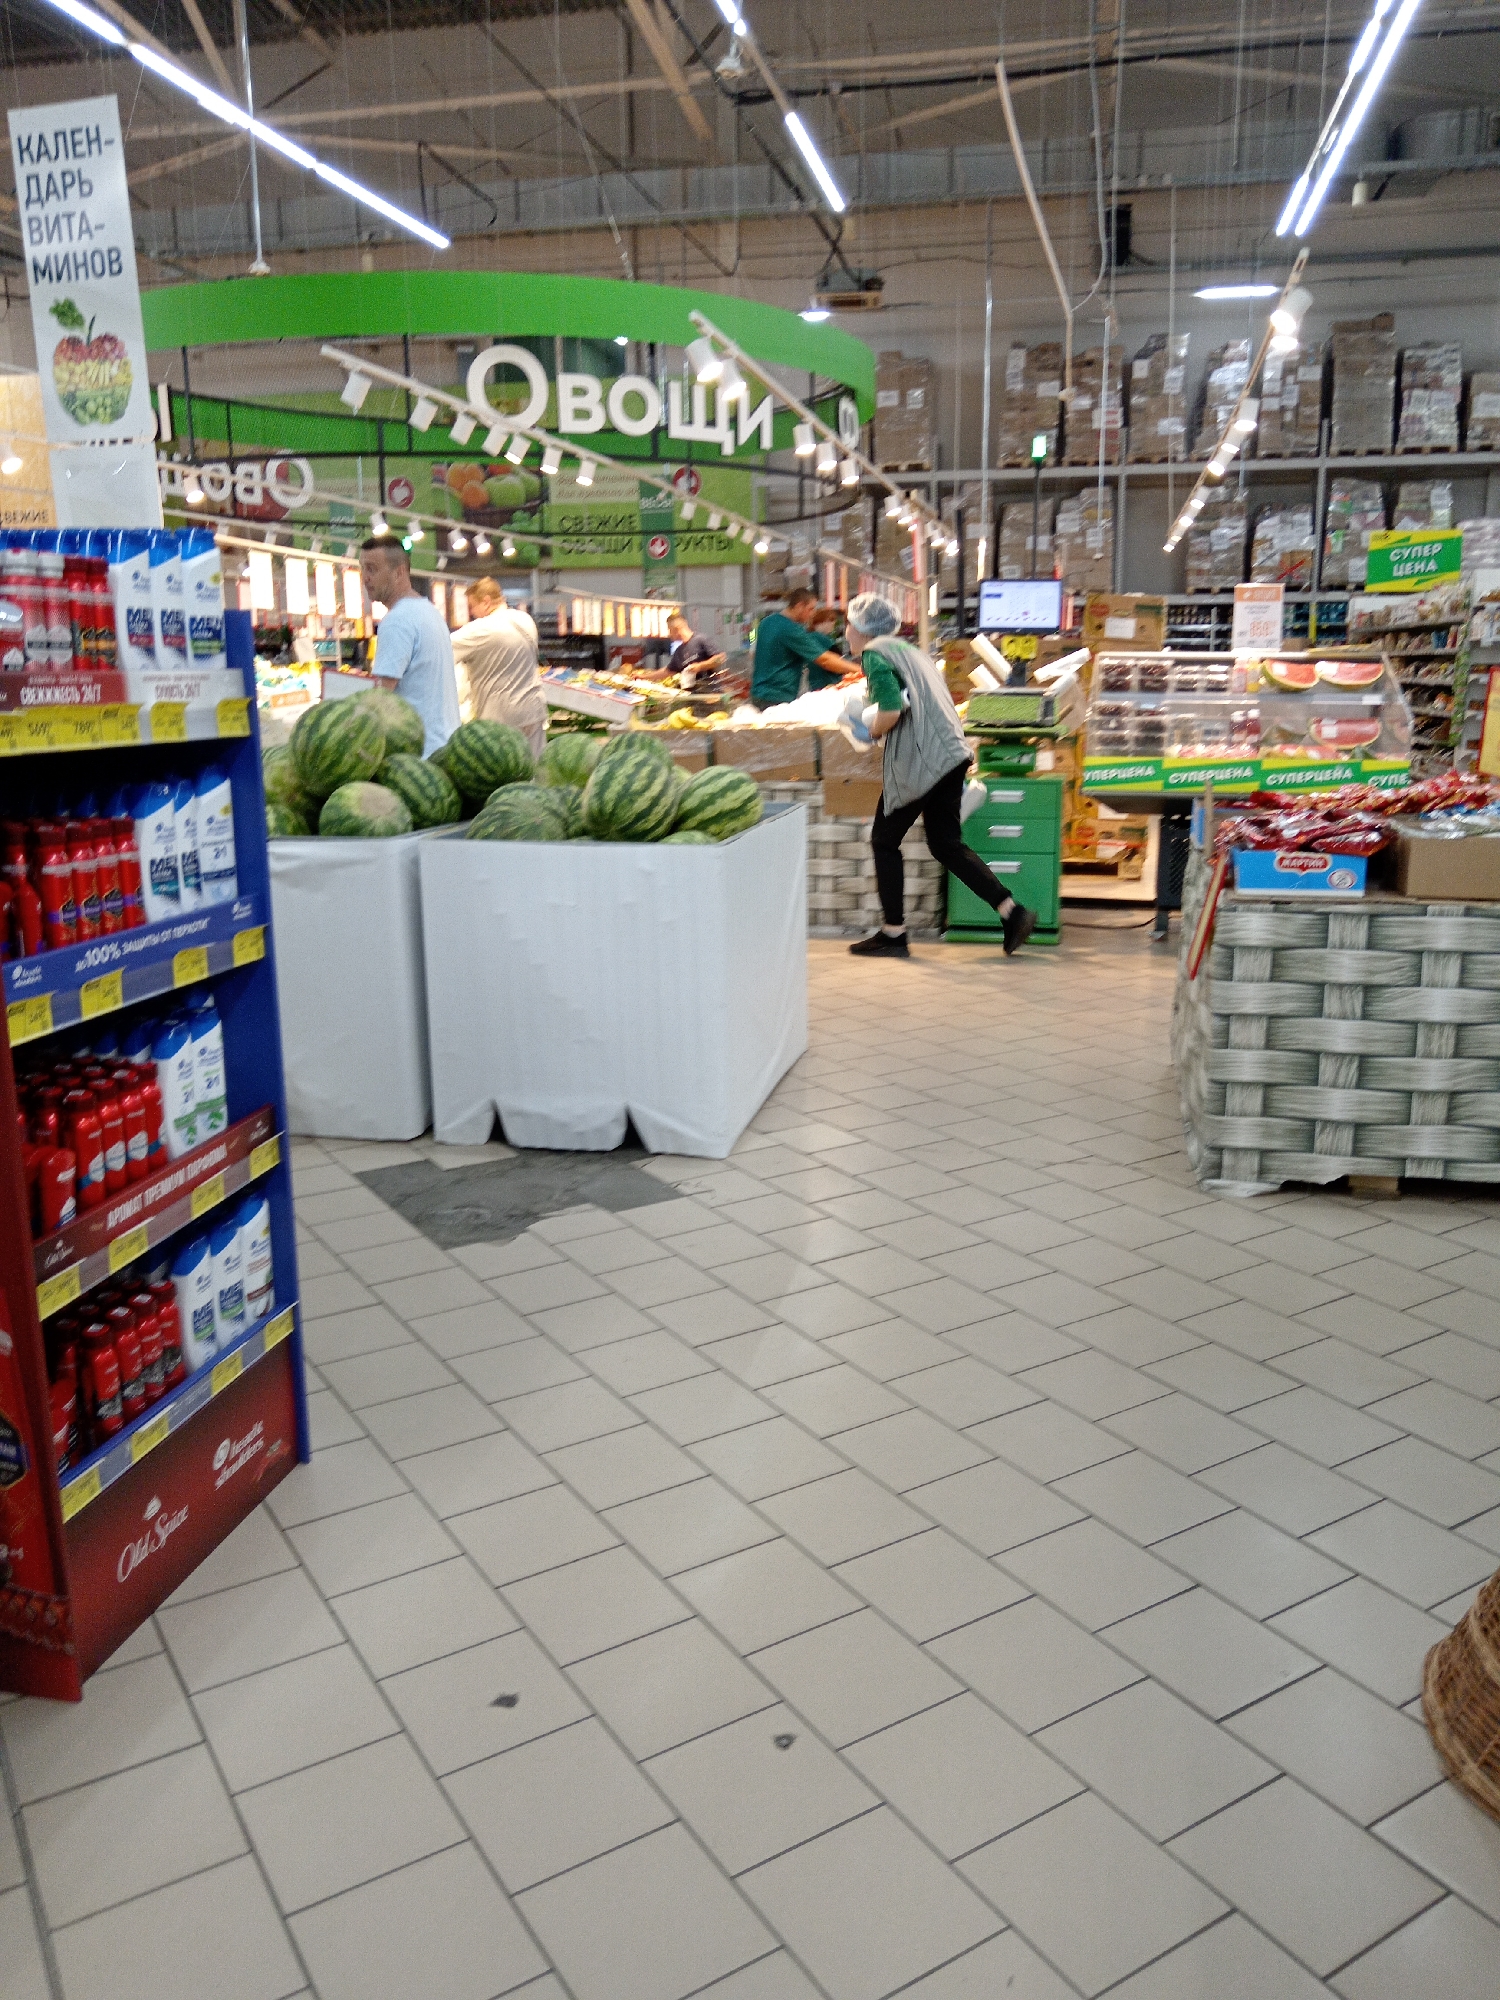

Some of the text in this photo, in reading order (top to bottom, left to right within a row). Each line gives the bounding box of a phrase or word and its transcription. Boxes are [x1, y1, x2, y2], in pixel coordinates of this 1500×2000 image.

[17, 125, 115, 165] КАЛЕН-
[25, 167, 93, 210] ДАРЬ
[27, 210, 105, 246] ВИТА-
[32, 246, 123, 285] МИНОВ
[558, 513, 637, 534] СВЕЖИЕ
[674, 533, 733, 552] РУКТЫ
[1389, 543, 1443, 562] СУПЕР
[1392, 559, 1438, 577] ЦЕНА
[1084, 765, 1411, 788] УПЕРЦЕНА СУПЕРЦЕНА СУПЕРЦЕНА СУПЕ
[117, 1503, 189, 1583] Old Spice
